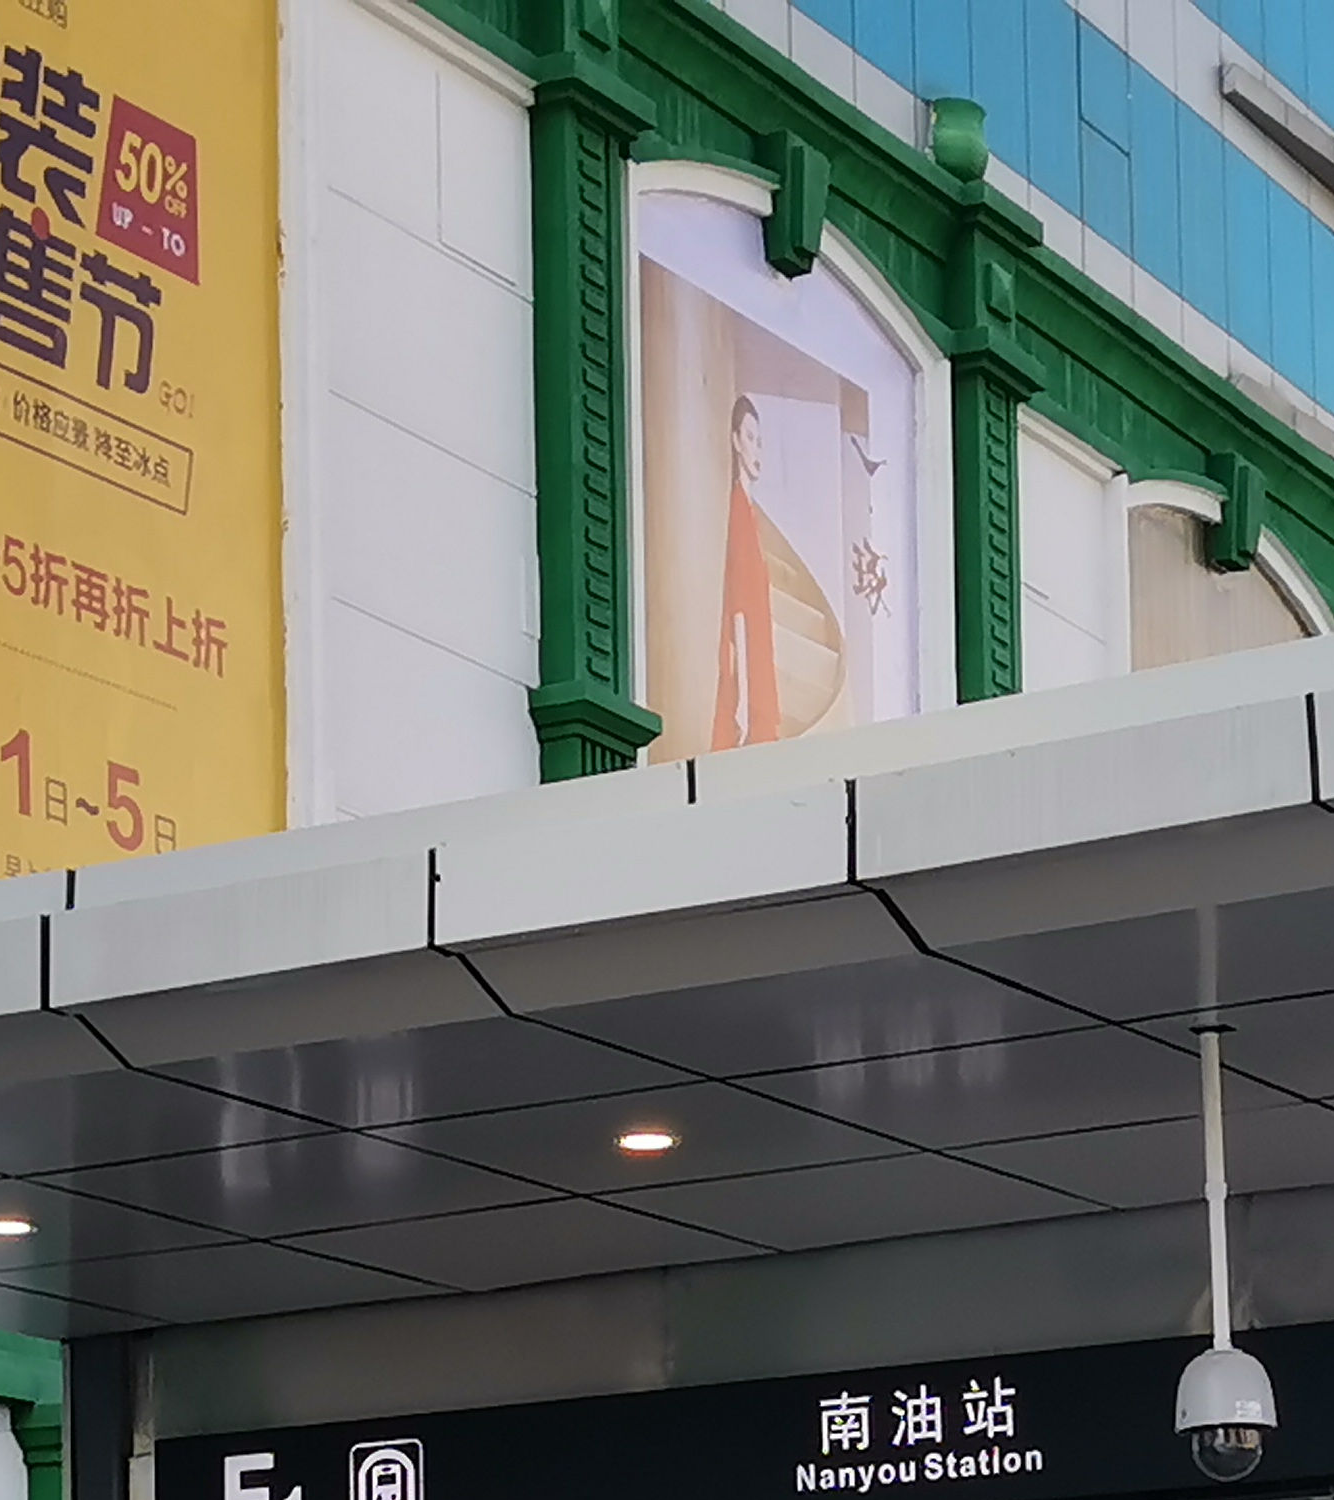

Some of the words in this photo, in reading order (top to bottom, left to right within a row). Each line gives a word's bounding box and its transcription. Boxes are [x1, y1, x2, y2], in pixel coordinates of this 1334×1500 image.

[114, 130, 188, 205] 50%
[819, 1375, 1016, 1455] 南油站
[796, 1459, 916, 1493] Nanyou
[924, 1445, 1043, 1481] Station
